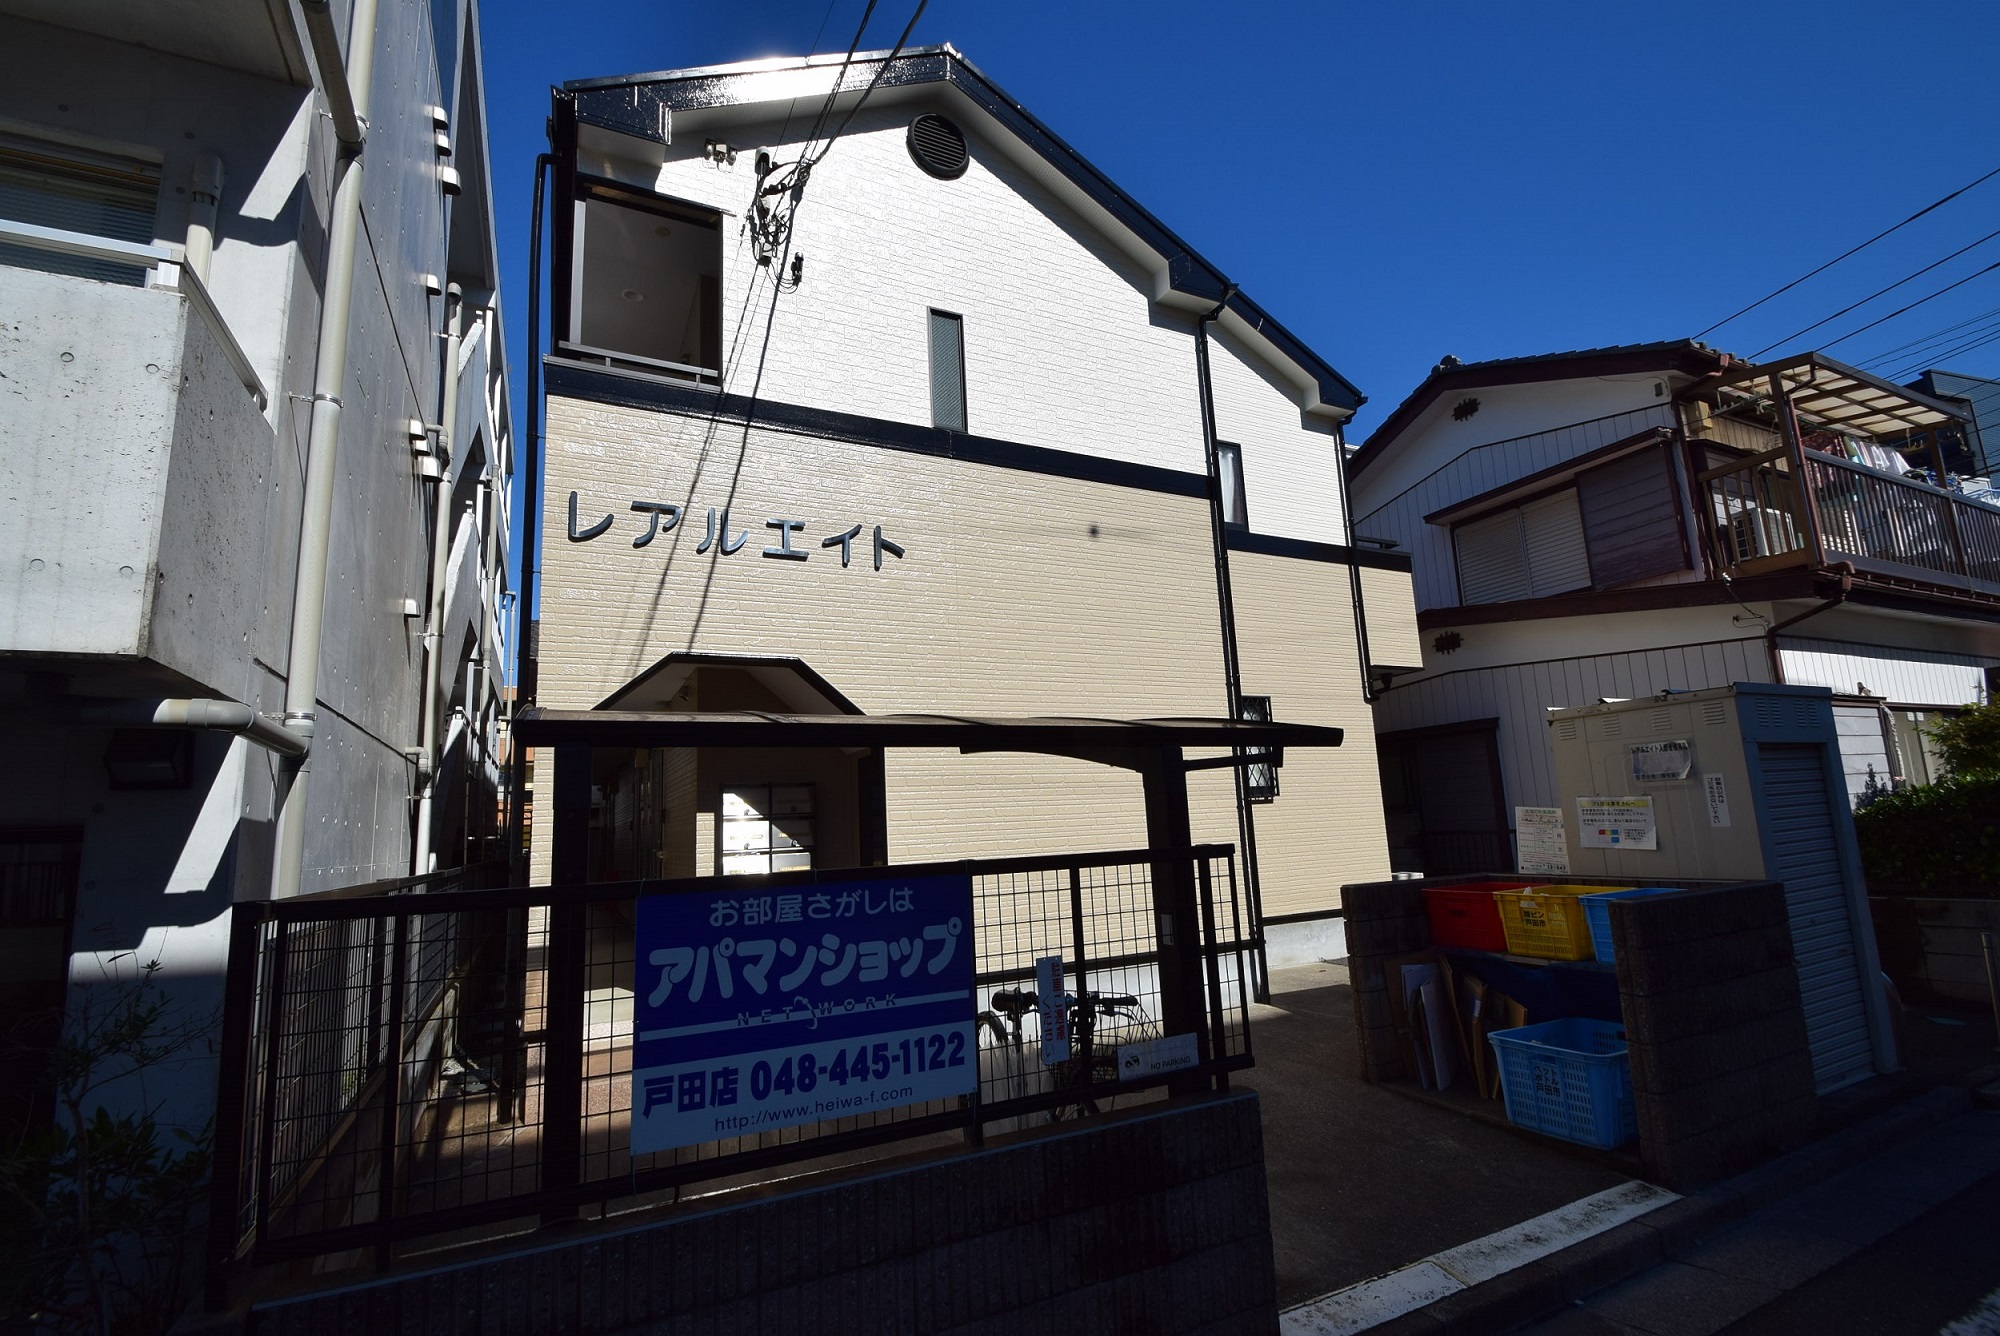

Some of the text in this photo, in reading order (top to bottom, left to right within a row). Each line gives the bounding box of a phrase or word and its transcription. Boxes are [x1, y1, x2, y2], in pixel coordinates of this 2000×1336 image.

[567, 490, 905, 572] レアルエイト
[709, 887, 914, 927] お部屋さがしは
[1525, 919, 1546, 927] 戸田市
[648, 916, 963, 1008] アパマンショップ
[737, 993, 898, 1027] NETWORK
[1042, 994, 1055, 1058] ください
[643, 1031, 965, 1120] 戸田店 048-445-1122
[1150, 1055, 1190, 1070] NO PARKING
[1535, 1065, 1557, 1077] ペット
[1535, 1074, 1559, 1085] ボトル
[1536, 1083, 1560, 1097] 戸田市
[714, 1086, 914, 1132] http://www.heiwa-f.com
